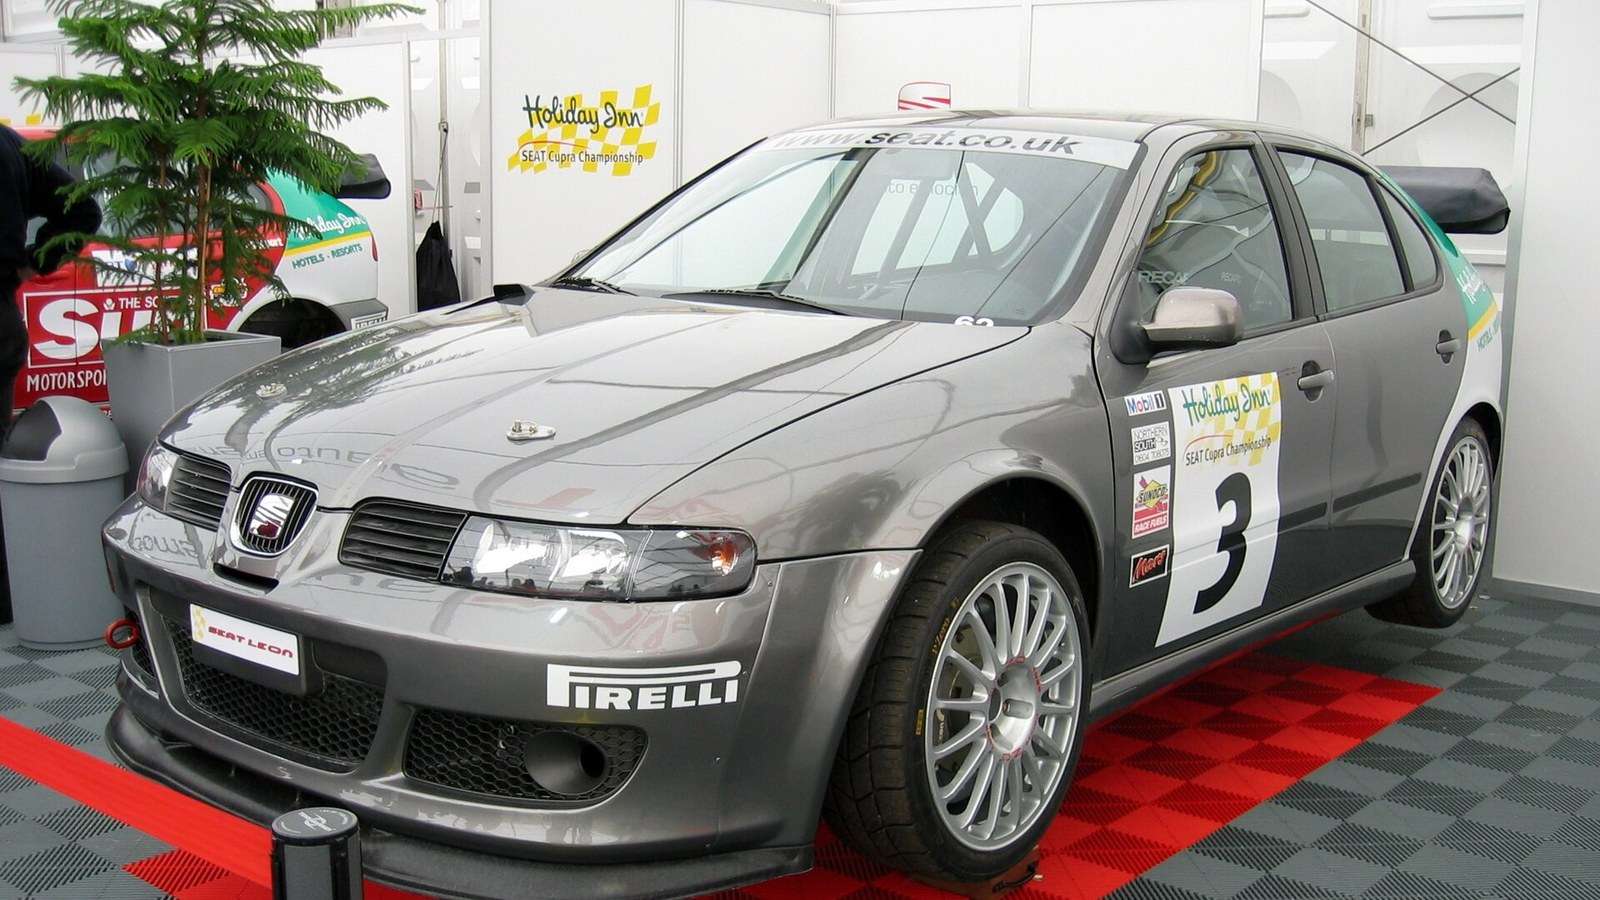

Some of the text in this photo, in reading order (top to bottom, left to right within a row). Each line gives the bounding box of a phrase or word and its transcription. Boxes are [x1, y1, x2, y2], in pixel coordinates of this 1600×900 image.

[522, 94, 644, 134] Holiday Inn
[521, 150, 644, 165] SEAT Cupra Championship
[291, 243, 363, 270] HOTELS RESORTS
[118, 297, 141, 310] THE
[26, 368, 107, 393] MOTORSPO
[1127, 394, 1154, 413] Mobil
[1181, 382, 1272, 427] Holiday Inn
[1185, 449, 1205, 466] SEAT
[1204, 447, 1225, 464] Cupra
[1225, 434, 1272, 458] Championship
[1134, 514, 1167, 533] RACE FUELS
[1193, 472, 1252, 615] 3
[208, 626, 294, 658] SEAT LEON
[546, 660, 742, 711] PIRELLI
